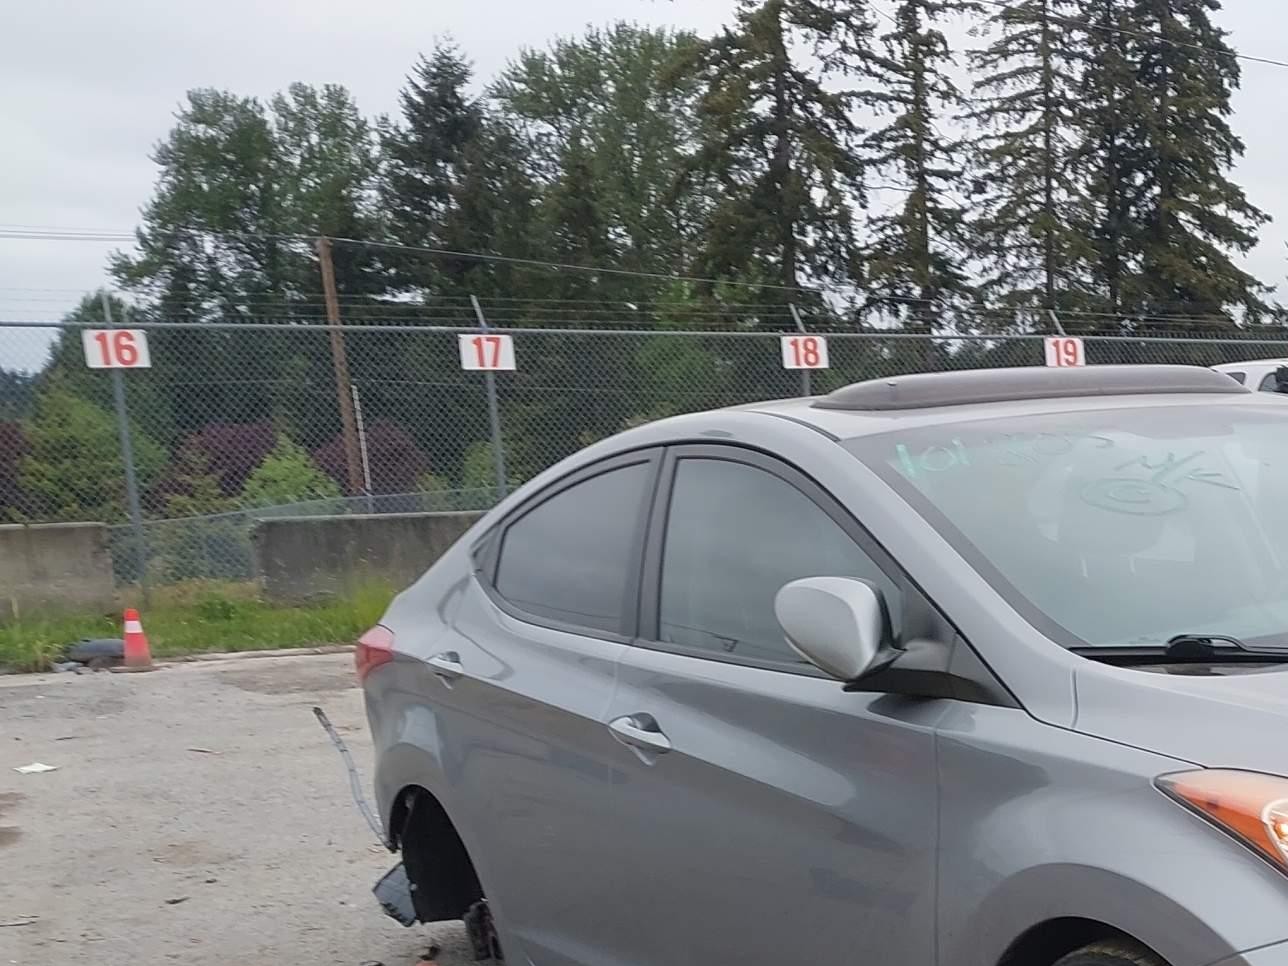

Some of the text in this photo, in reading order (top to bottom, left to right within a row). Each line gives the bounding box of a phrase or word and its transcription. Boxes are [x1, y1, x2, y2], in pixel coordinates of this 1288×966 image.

[95, 331, 139, 367] 16
[472, 335, 501, 369] 17
[790, 336, 820, 368] 18
[1053, 339, 1079, 367] 19
